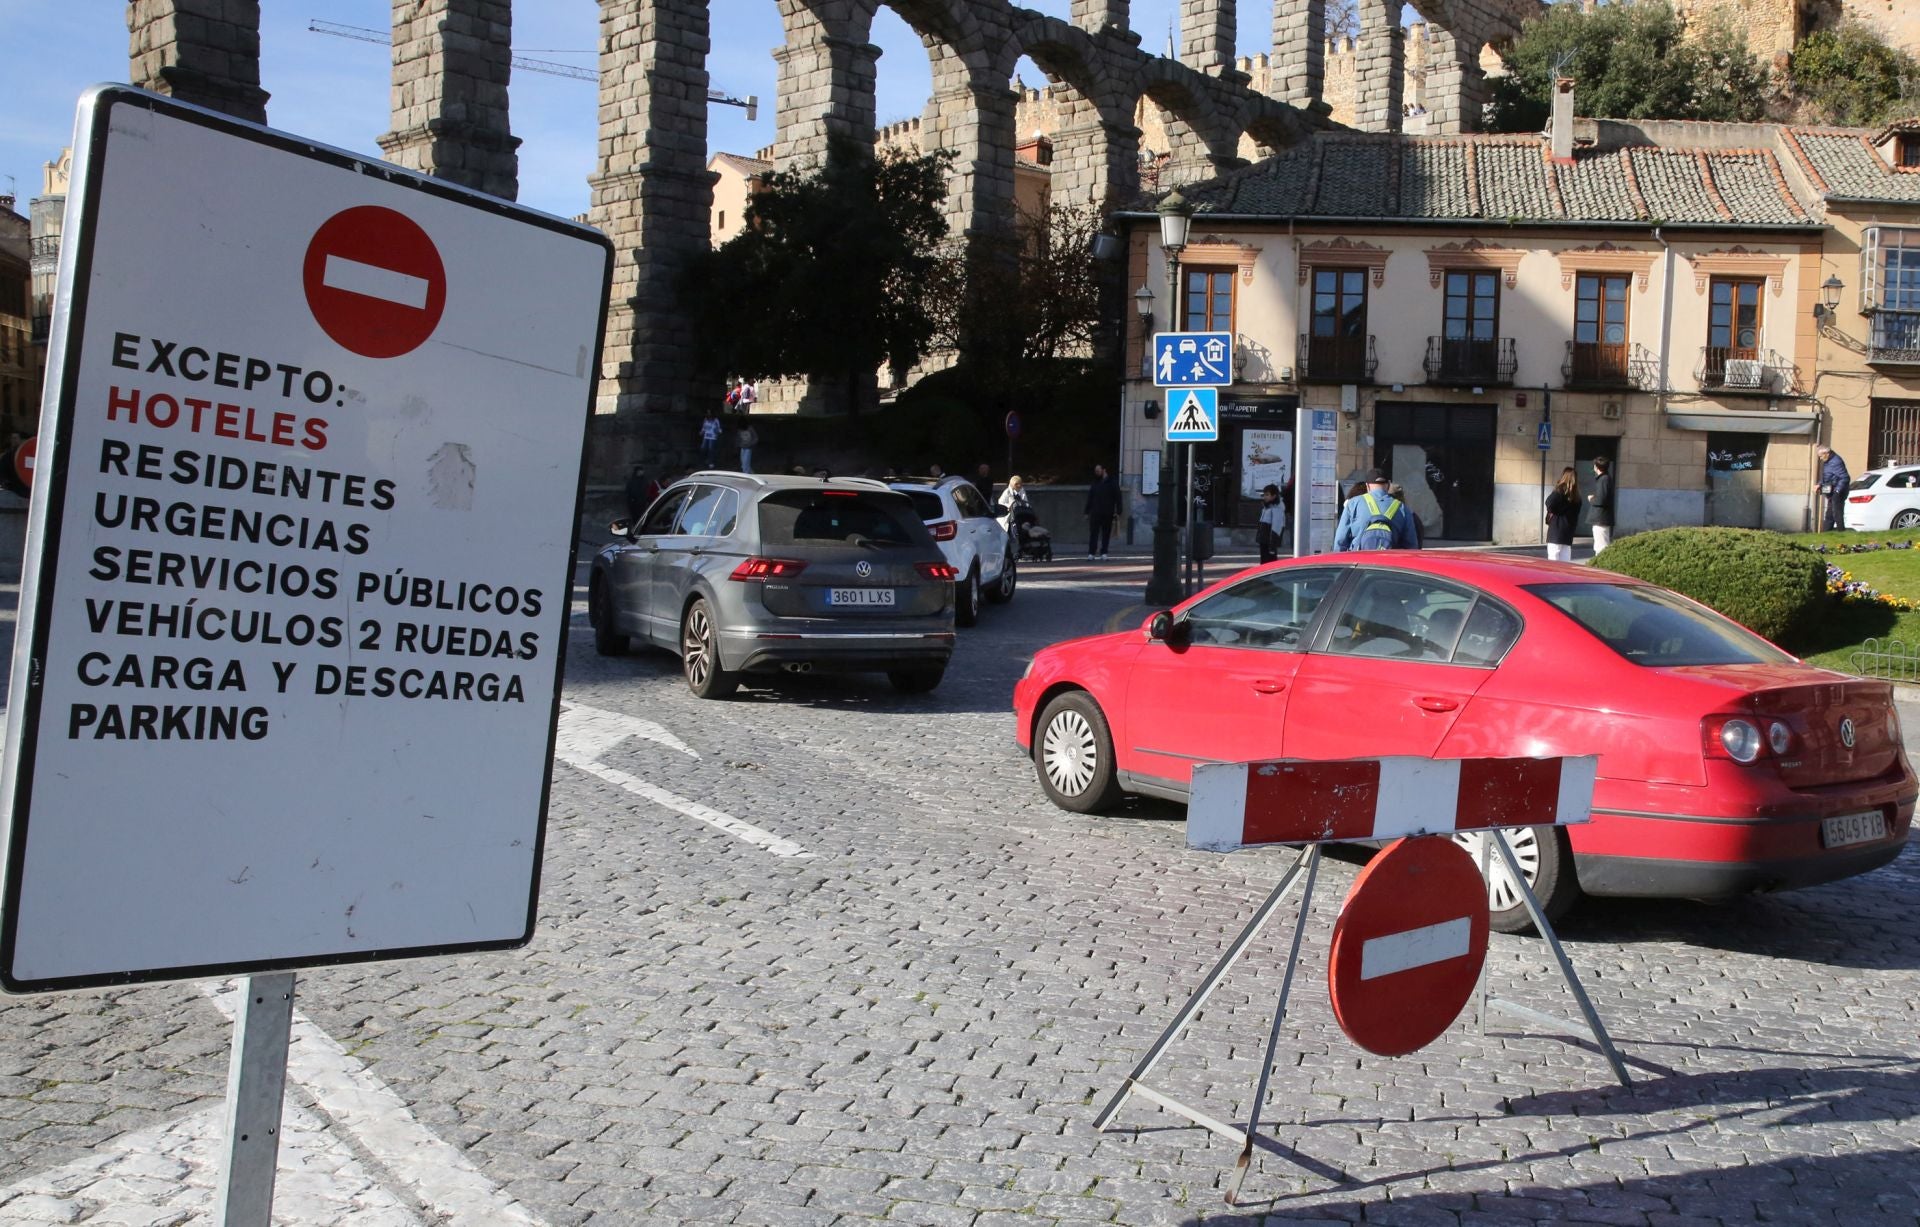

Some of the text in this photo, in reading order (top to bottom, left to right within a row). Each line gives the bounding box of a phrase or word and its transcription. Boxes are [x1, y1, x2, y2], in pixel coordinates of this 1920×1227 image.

[112, 332, 346, 408] EXCEPTO:
[107, 386, 328, 450] HOTELES
[1235, 405, 1258, 413] APPETIT
[100, 439, 396, 510] RESIDENTES
[95, 492, 370, 555] URGENCIAS
[89, 546, 543, 618] SERVICIOS PÚBLICOS
[834, 591, 892, 603] 3601 LXS
[85, 598, 539, 660] VEHÍCULOS 2 RUEDAS
[77, 652, 524, 703] CARGA Y DESCARGA
[68, 704, 269, 741] PARKING
[1829, 814, 1883, 842] 5649 FXB
